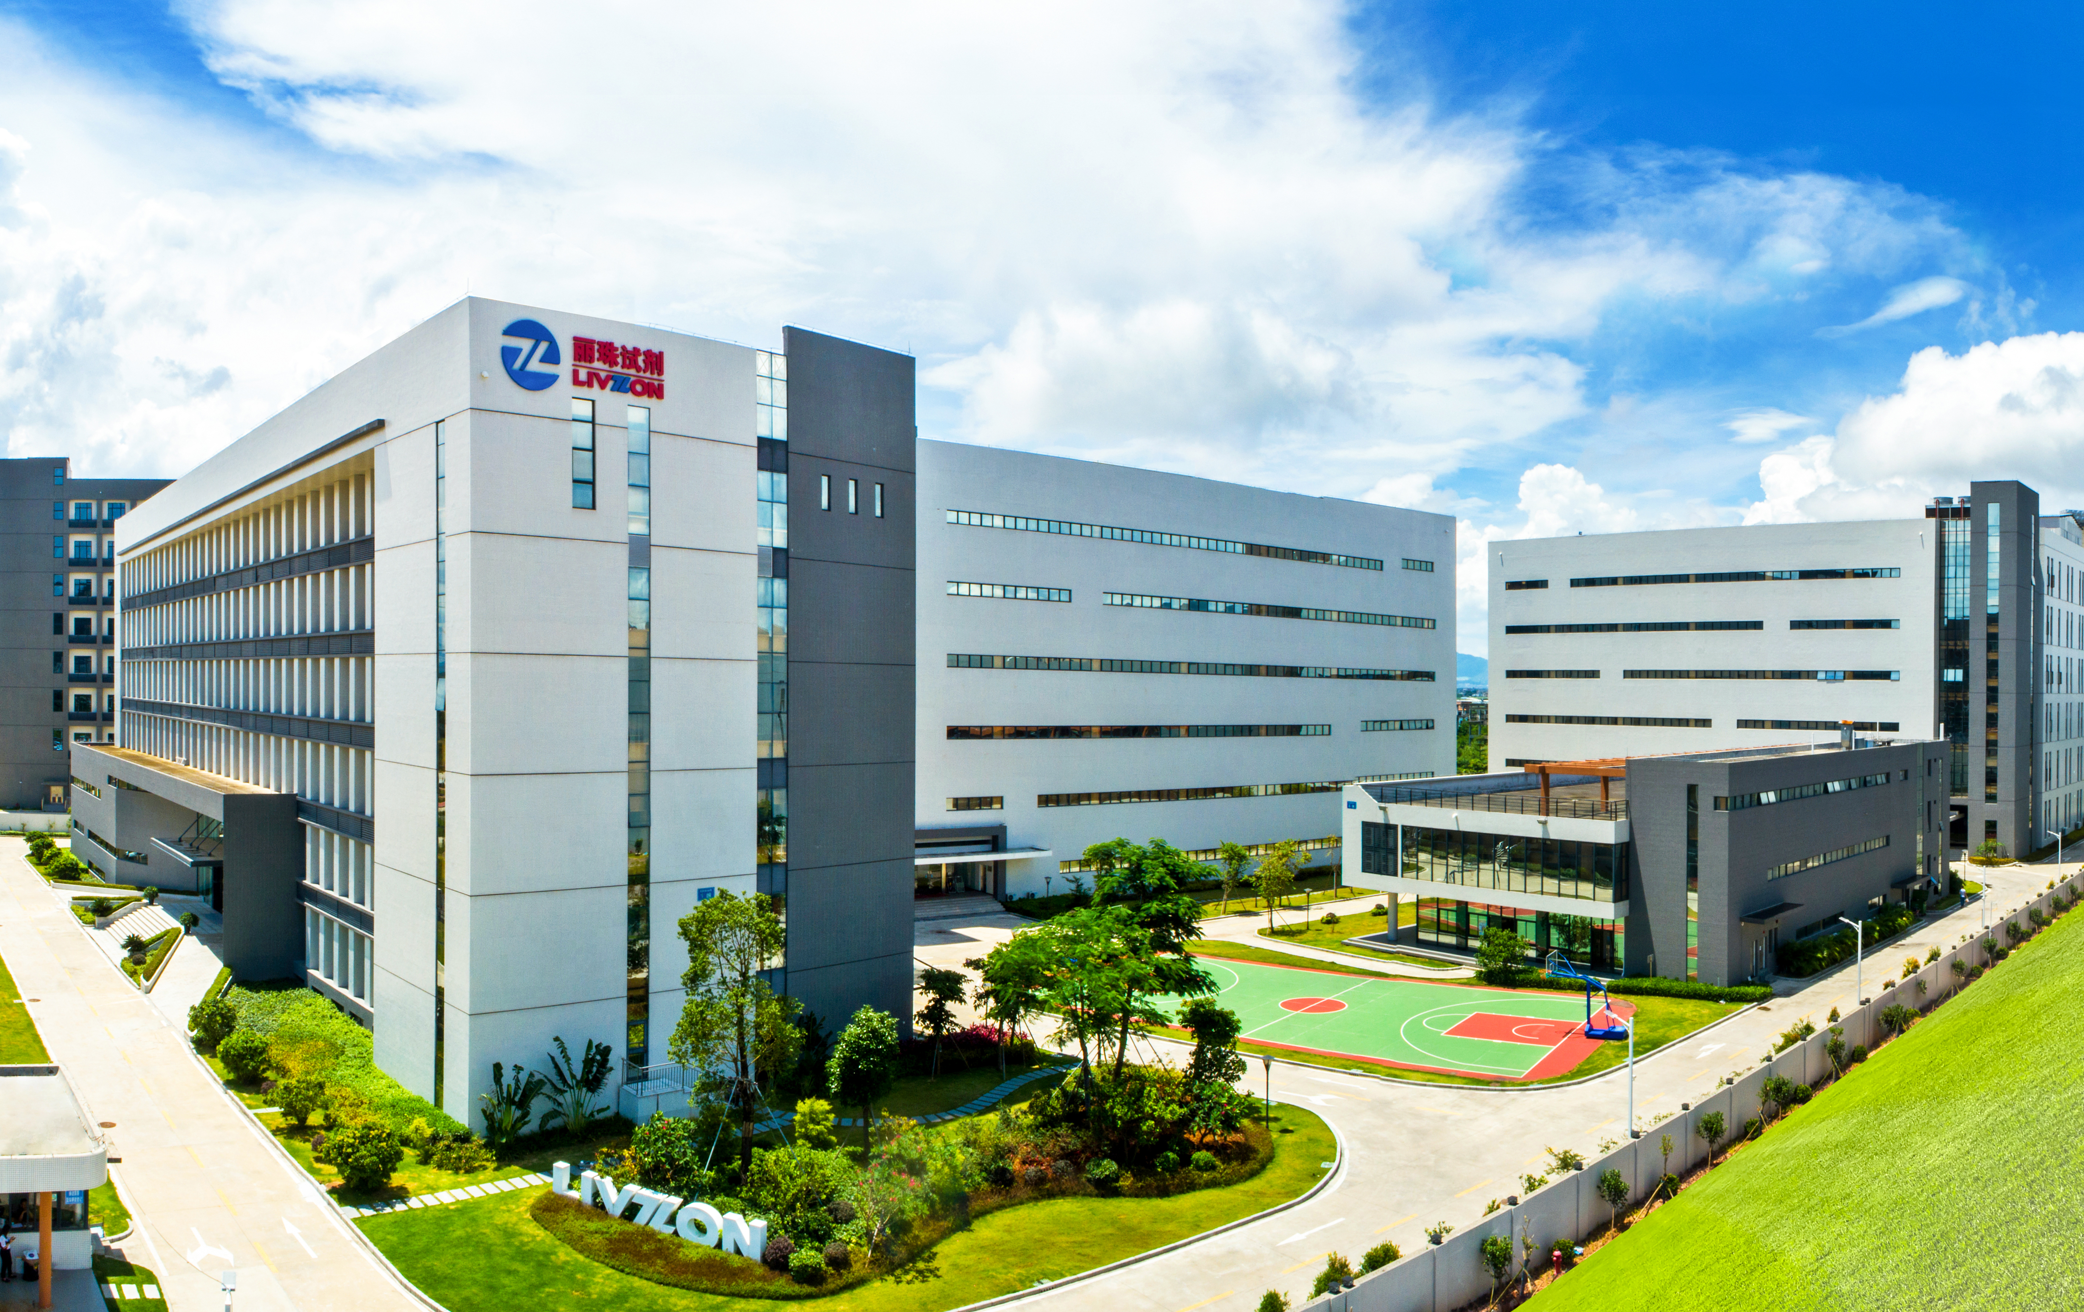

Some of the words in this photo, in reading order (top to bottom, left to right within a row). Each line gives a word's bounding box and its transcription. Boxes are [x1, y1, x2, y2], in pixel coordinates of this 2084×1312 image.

[572, 336, 665, 376] 丽珠试剂
[572, 368, 665, 400] LIVZON
[553, 1161, 768, 1262] LIVZON
